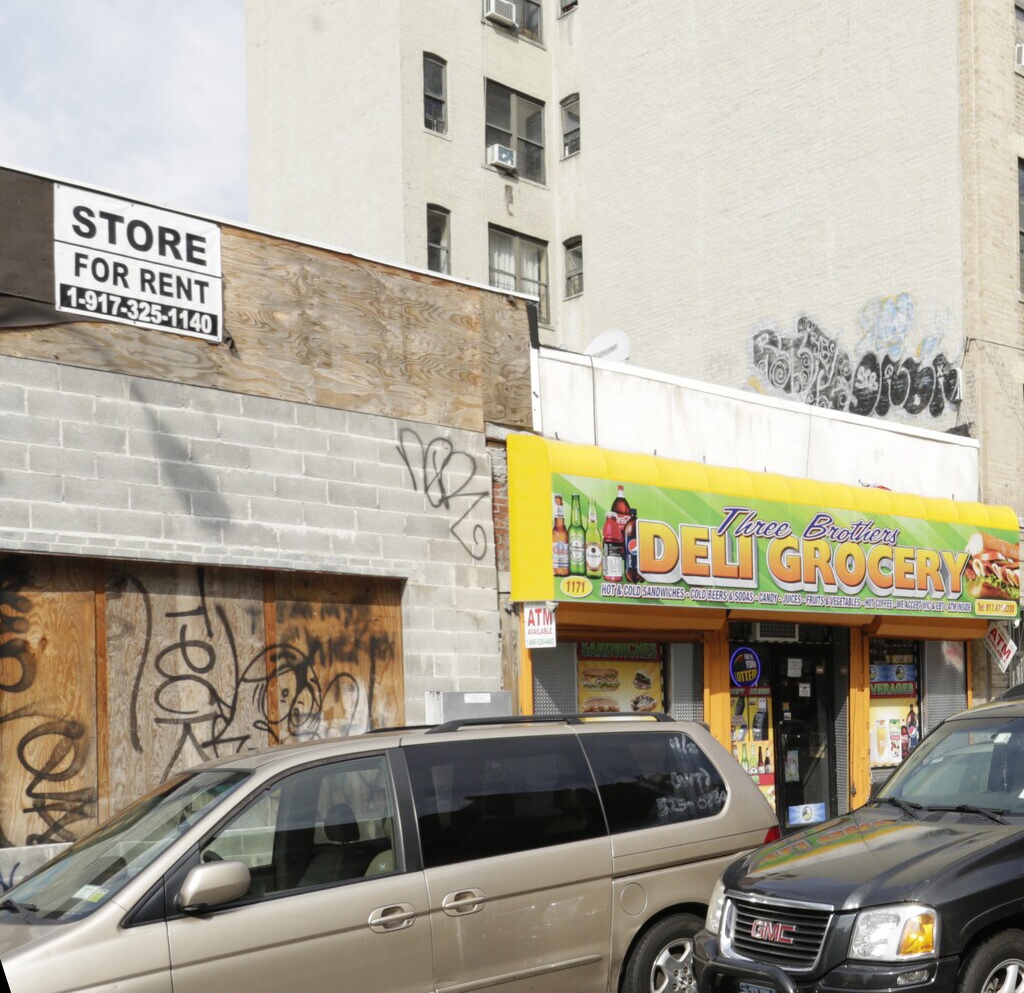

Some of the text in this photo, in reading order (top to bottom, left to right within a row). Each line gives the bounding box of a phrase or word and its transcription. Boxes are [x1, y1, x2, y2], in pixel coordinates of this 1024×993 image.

[72, 205, 207, 266] STORE
[74, 252, 209, 304] FOR RENT
[66, 287, 212, 334] 1-917-325-1140
[715, 506, 901, 545] Three Brothers
[636, 519, 970, 597] DELI GROCERY
[566, 581, 586, 593] 1171
[601, 583, 616, 596] HOT
[623, 585, 641, 597] COLD
[642, 586, 685, 599] SANDWICHES
[690, 588, 707, 600] COLD
[708, 589, 727, 601] BEERS
[734, 591, 754, 602] SODAS
[759, 592, 778, 604] CANDY
[782, 594, 801, 605] JUICES
[806, 595, 824, 605] FRUITS
[830, 597, 861, 607] VEGETABLES
[874, 598, 893, 608] COFFEE
[904, 599, 921, 610] ACCEPT
[957, 602, 971, 613] INSIDE
[528, 608, 552, 626] ATM
[581, 641, 658, 659] SANDWICHES
[990, 627, 1011, 659] ATM
[870, 682, 914, 695] VERAGES
[751, 919, 796, 944] GMC
